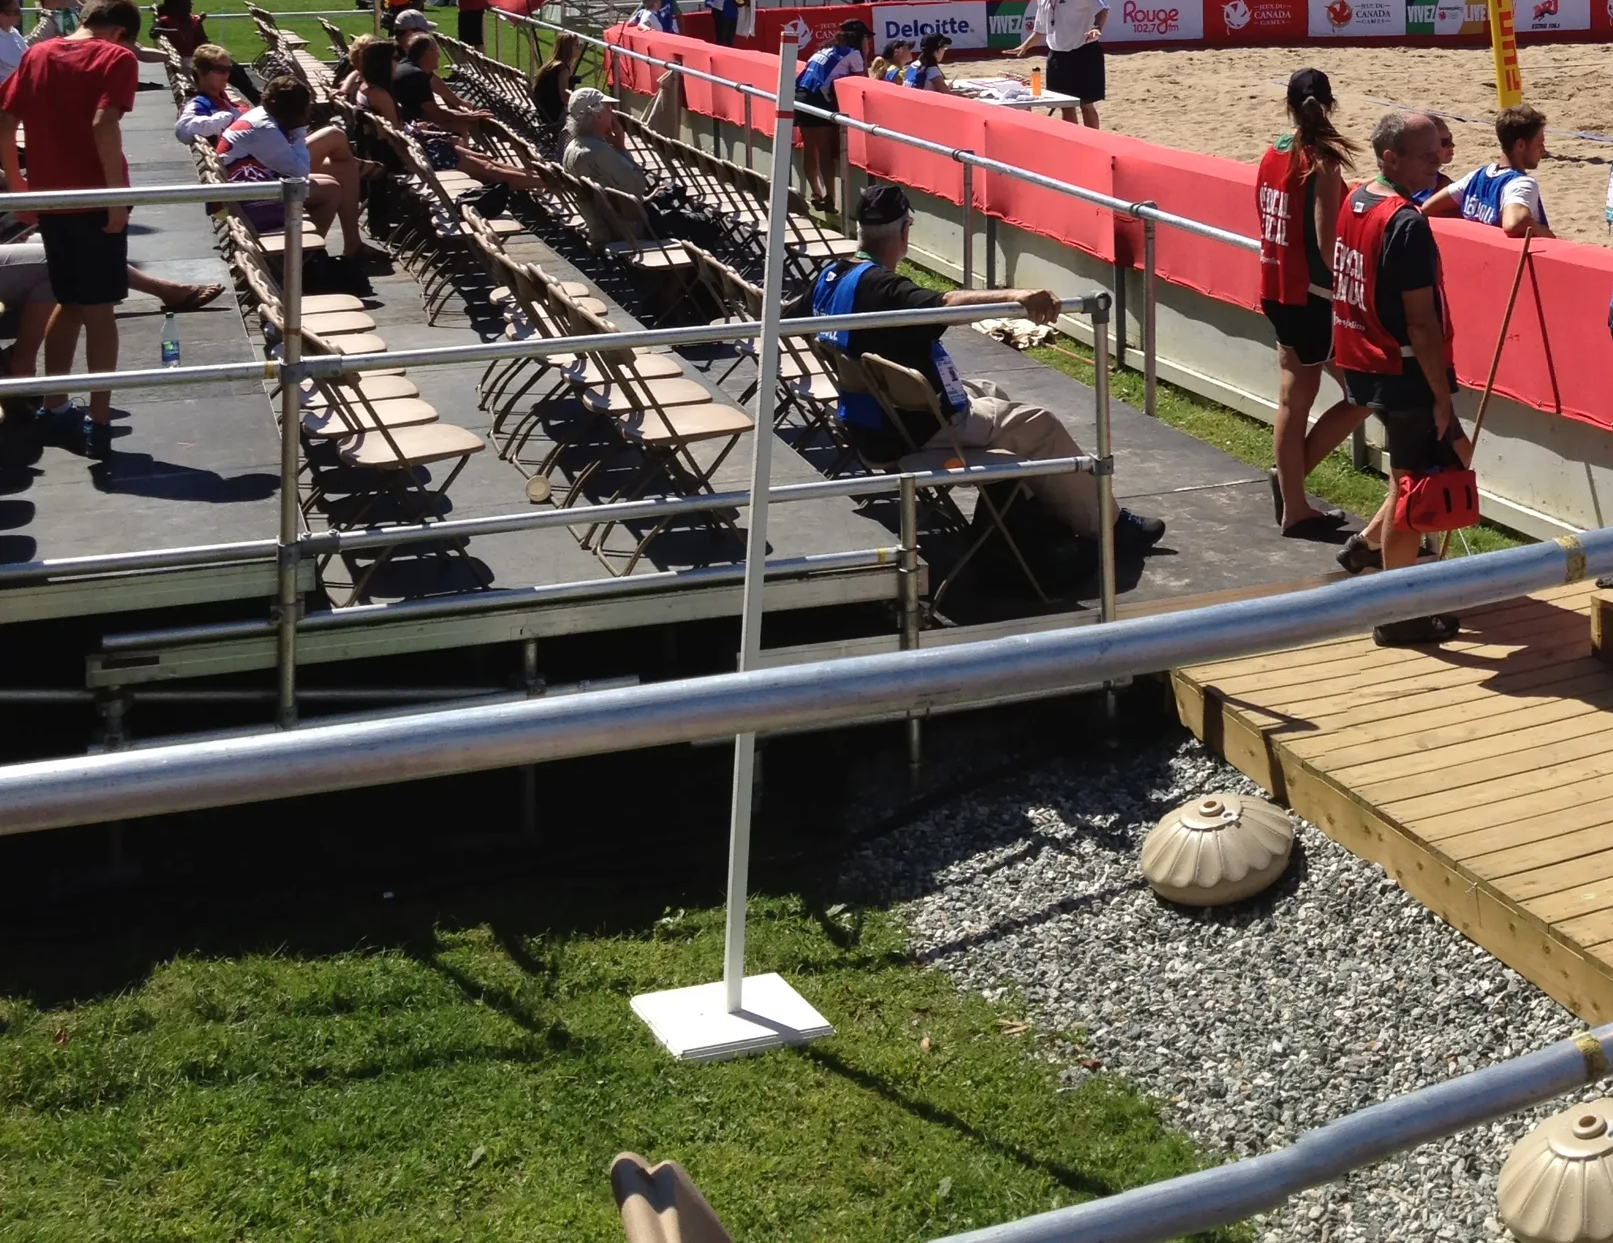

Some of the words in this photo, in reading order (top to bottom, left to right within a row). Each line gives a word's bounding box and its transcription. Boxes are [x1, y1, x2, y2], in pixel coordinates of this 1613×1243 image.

[1123, 0, 1179, 35] Rouge
[1253, 10, 1292, 20] CANADA
[1355, 9, 1391, 18] CANADA
[1407, 4, 1435, 23] VIVEZ
[1465, 4, 1486, 22] LIVE
[885, 17, 970, 39] Deloitte
[988, 14, 1023, 35] VIVEZ
[1132, 24, 1158, 34] 102.7
[1167, 22, 1179, 32] fm
